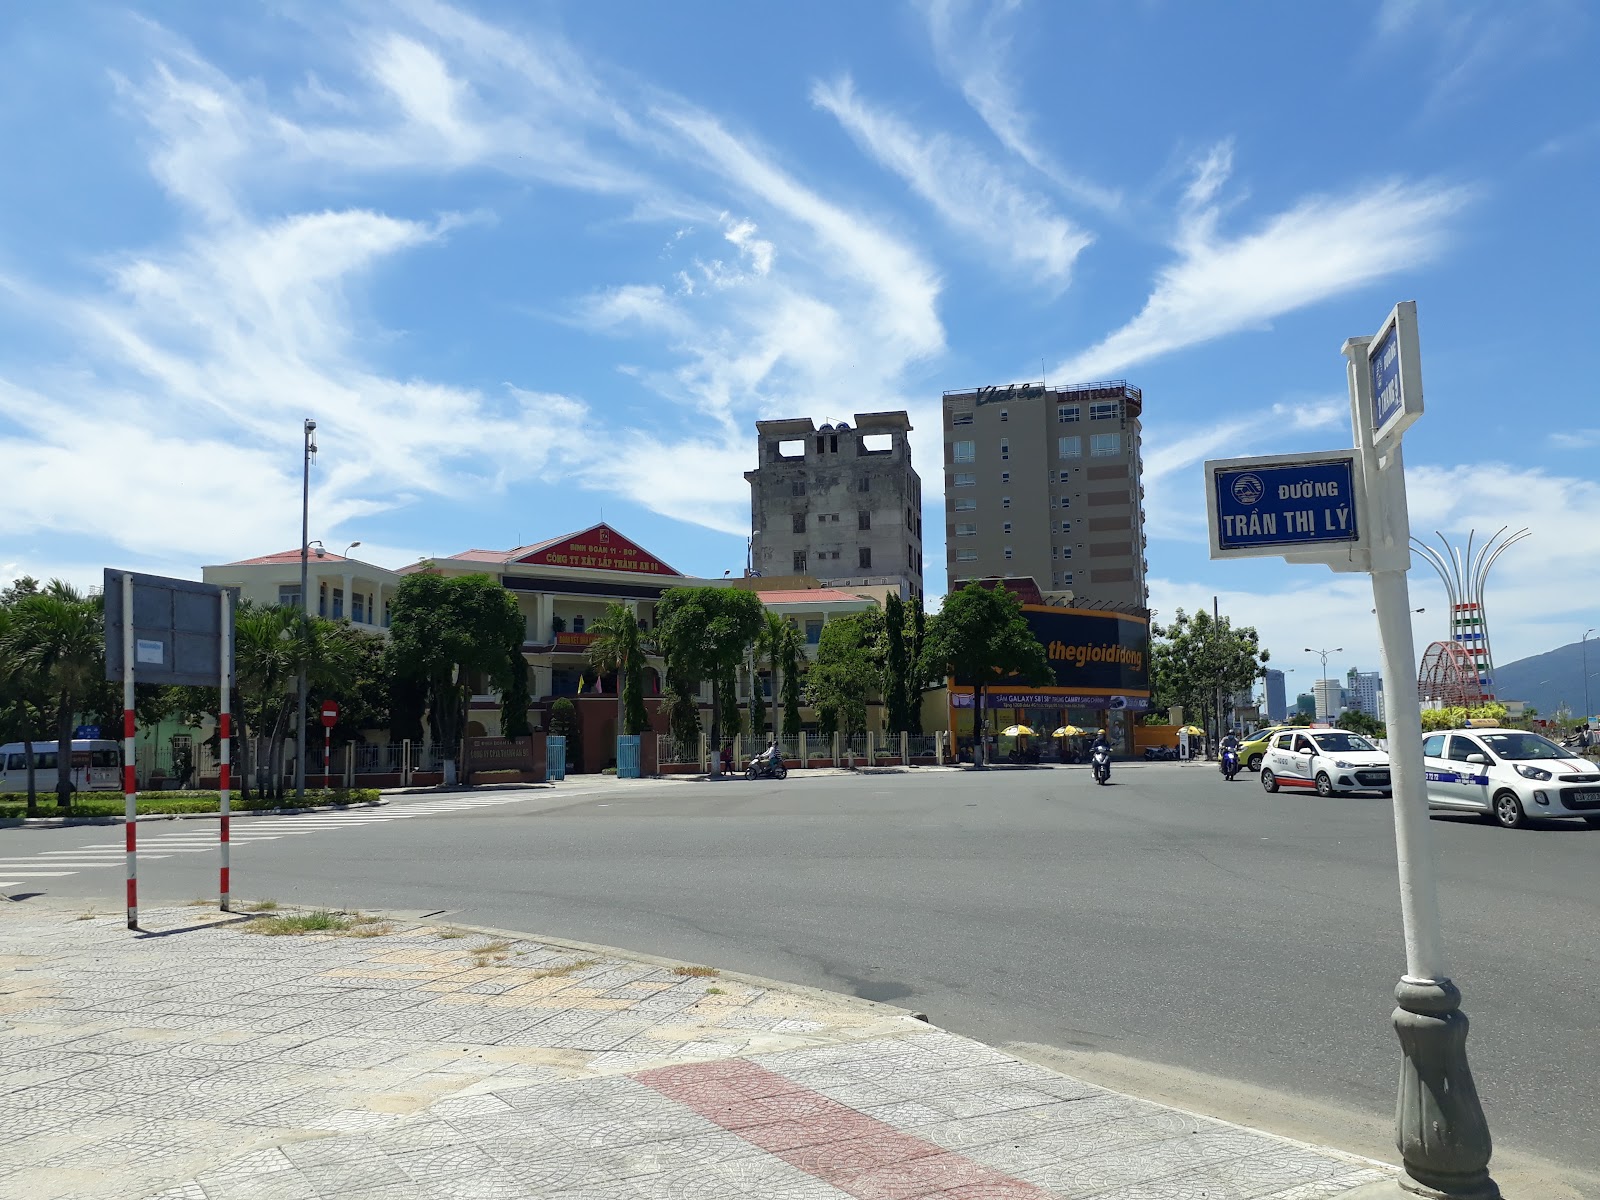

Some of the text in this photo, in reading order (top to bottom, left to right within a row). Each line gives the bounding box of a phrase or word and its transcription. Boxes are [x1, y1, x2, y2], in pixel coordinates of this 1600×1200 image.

[1384, 341, 1396, 370] ĐƯỜNG
[1278, 479, 1338, 500] ĐƯỜNG
[1223, 503, 1349, 537] TRẦN THỊ LÝ
[546, 552, 568, 564] CÔNG
[569, 555, 580, 564] TY
[1048, 641, 1142, 671] thegioididong
